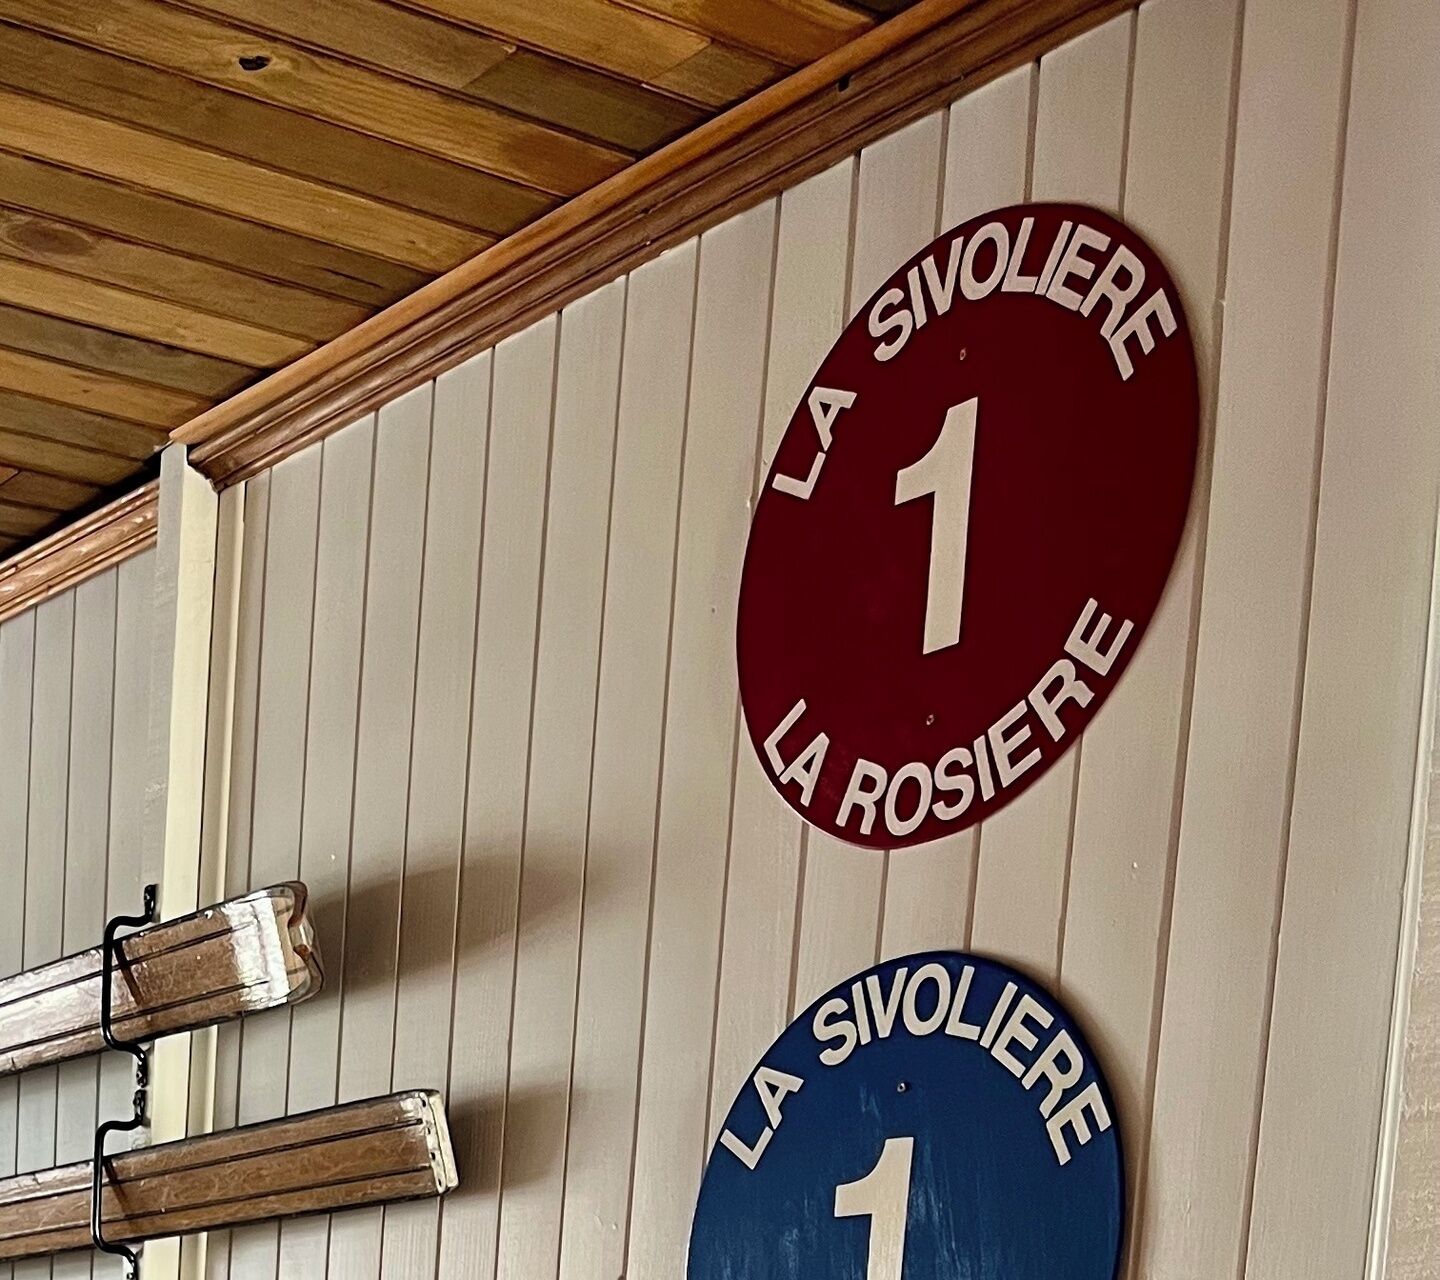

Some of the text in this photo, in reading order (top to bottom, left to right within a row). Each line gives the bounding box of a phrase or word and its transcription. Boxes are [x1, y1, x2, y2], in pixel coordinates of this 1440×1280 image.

[772, 217, 1177, 499] LA SIVOLIERE
[894, 396, 978, 654] 1
[763, 598, 1134, 836] LA ROSIERE
[720, 964, 1111, 1170] LA SIVOLIERE
